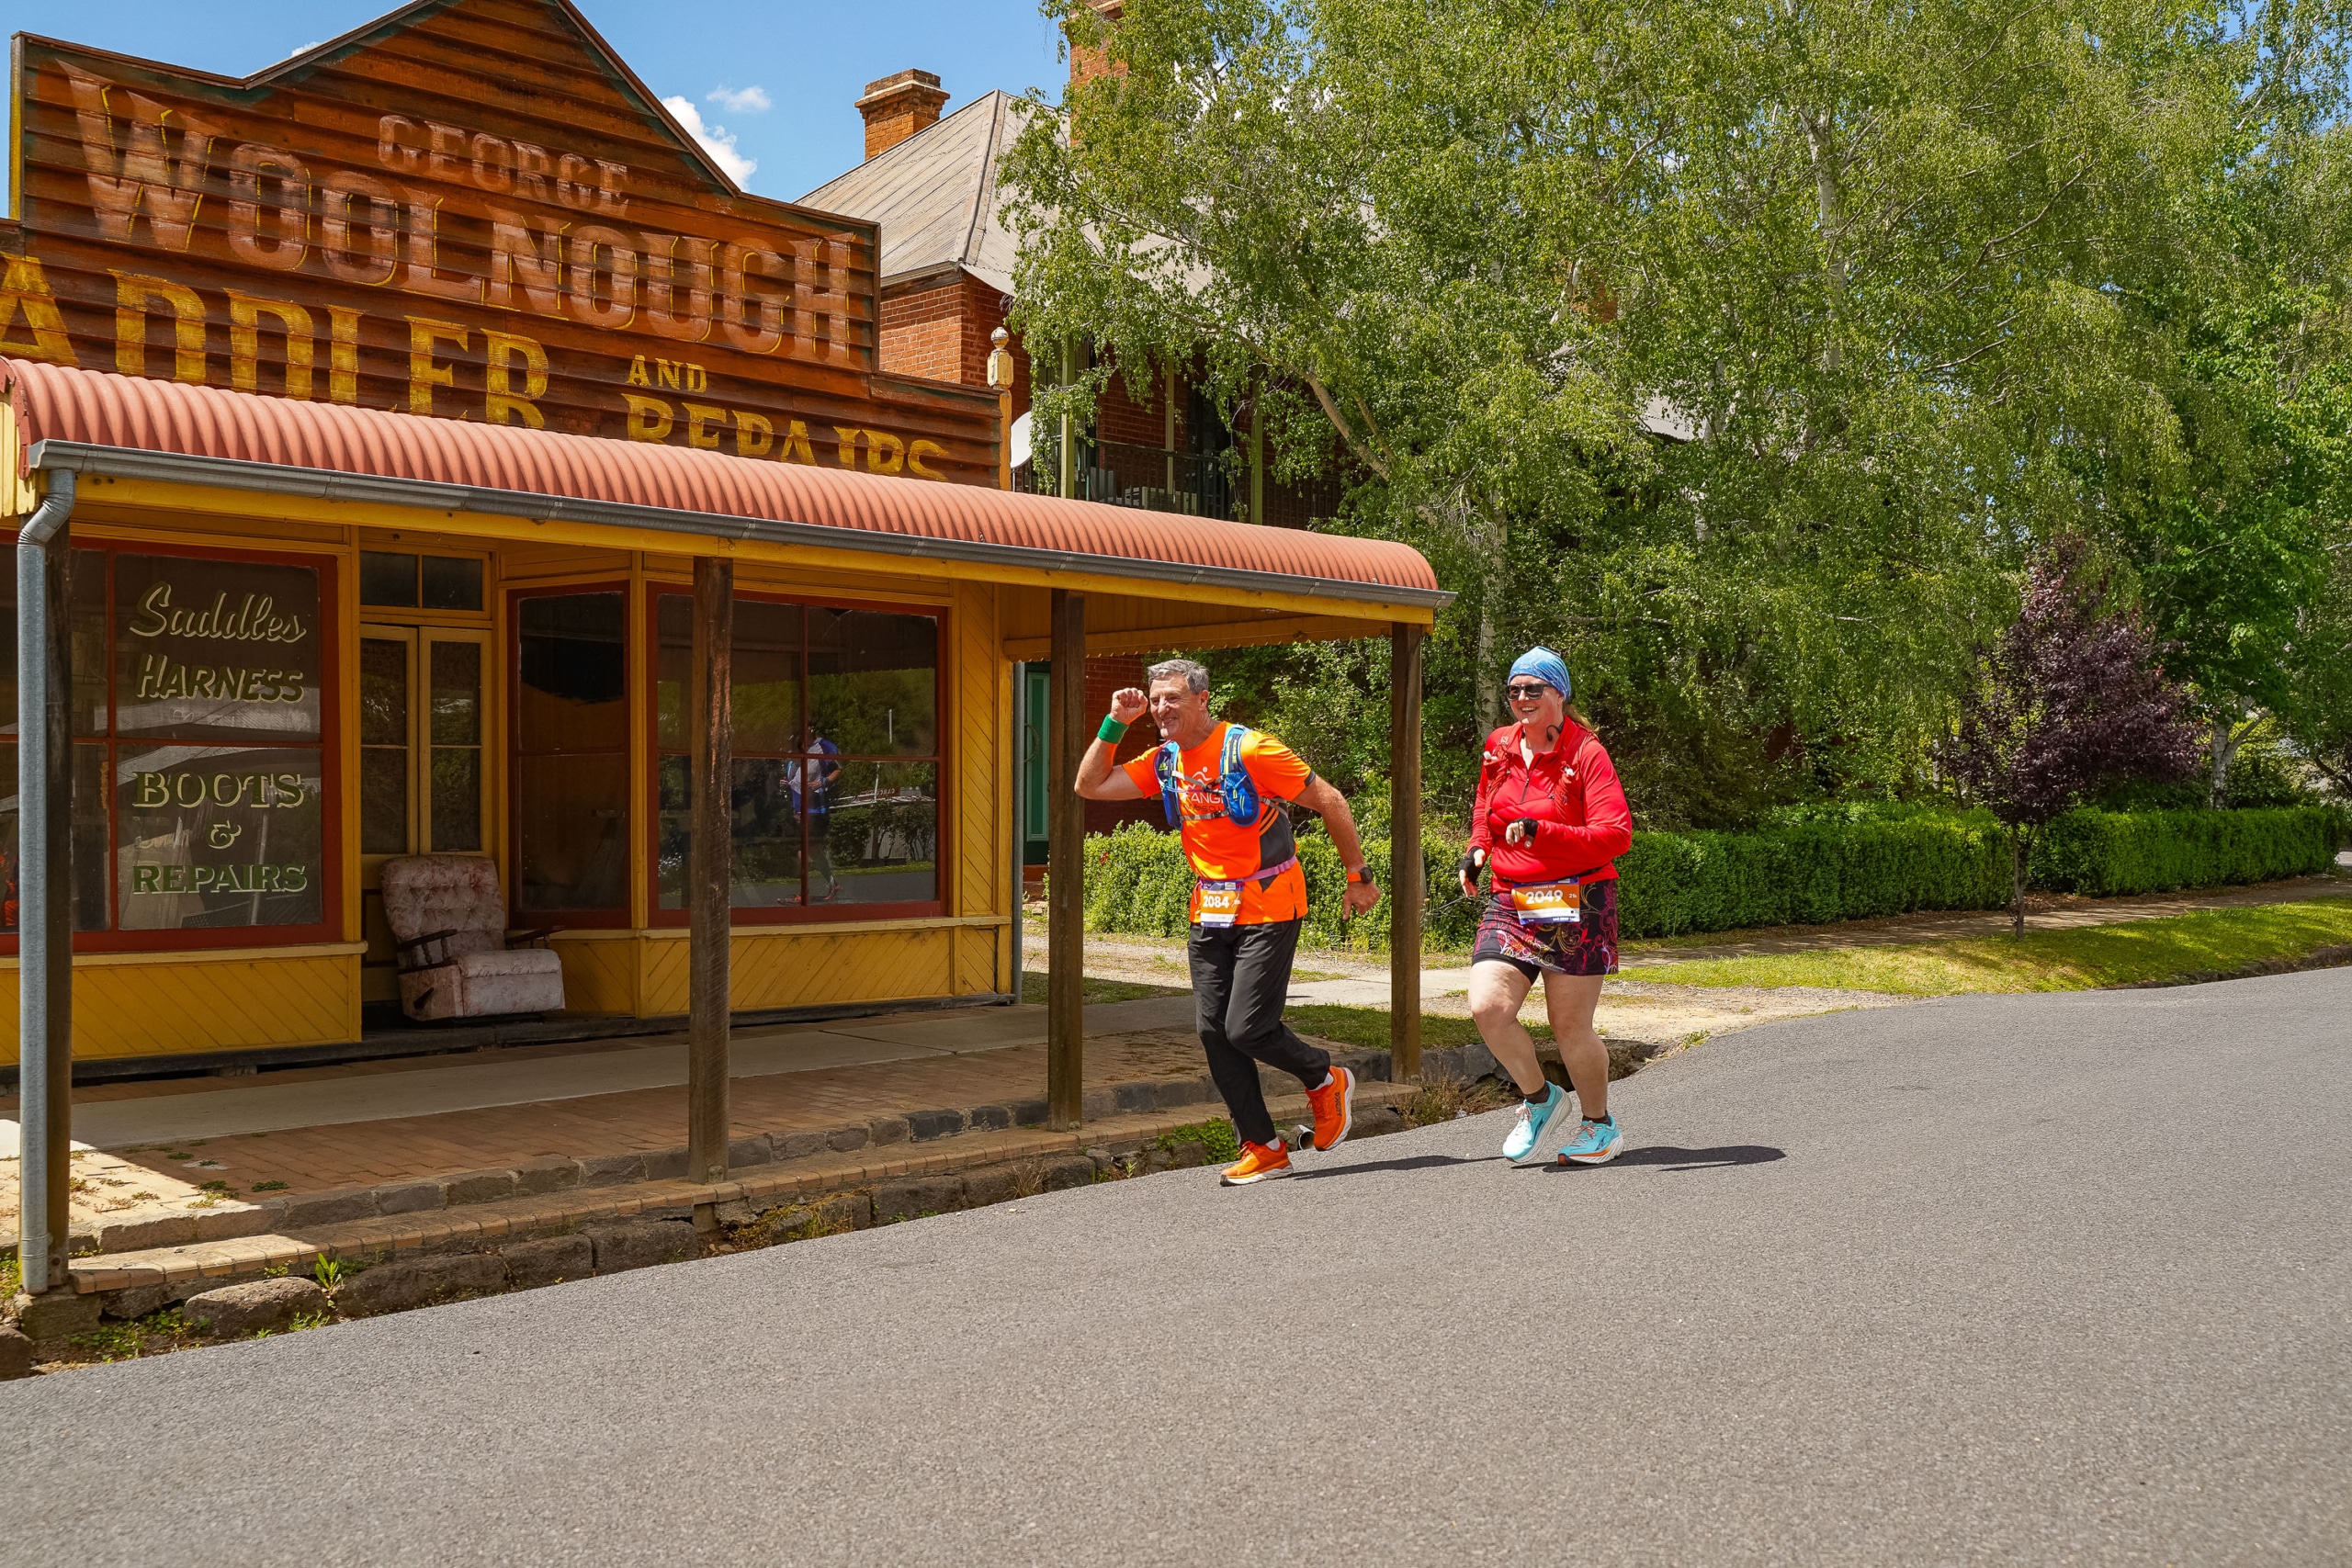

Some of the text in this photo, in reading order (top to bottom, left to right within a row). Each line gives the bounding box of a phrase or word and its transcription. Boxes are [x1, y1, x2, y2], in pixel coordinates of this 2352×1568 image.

[378, 114, 635, 218] GEORGE
[627, 354, 708, 394] AND
[130, 580, 307, 644] Saddles
[135, 652, 305, 704] HARNESS
[131, 772, 306, 809] BOOTS
[207, 820, 243, 850] &
[132, 863, 308, 895] REPAIRS
[1525, 889, 1564, 905] 2049
[1203, 895, 1230, 908] 2084
